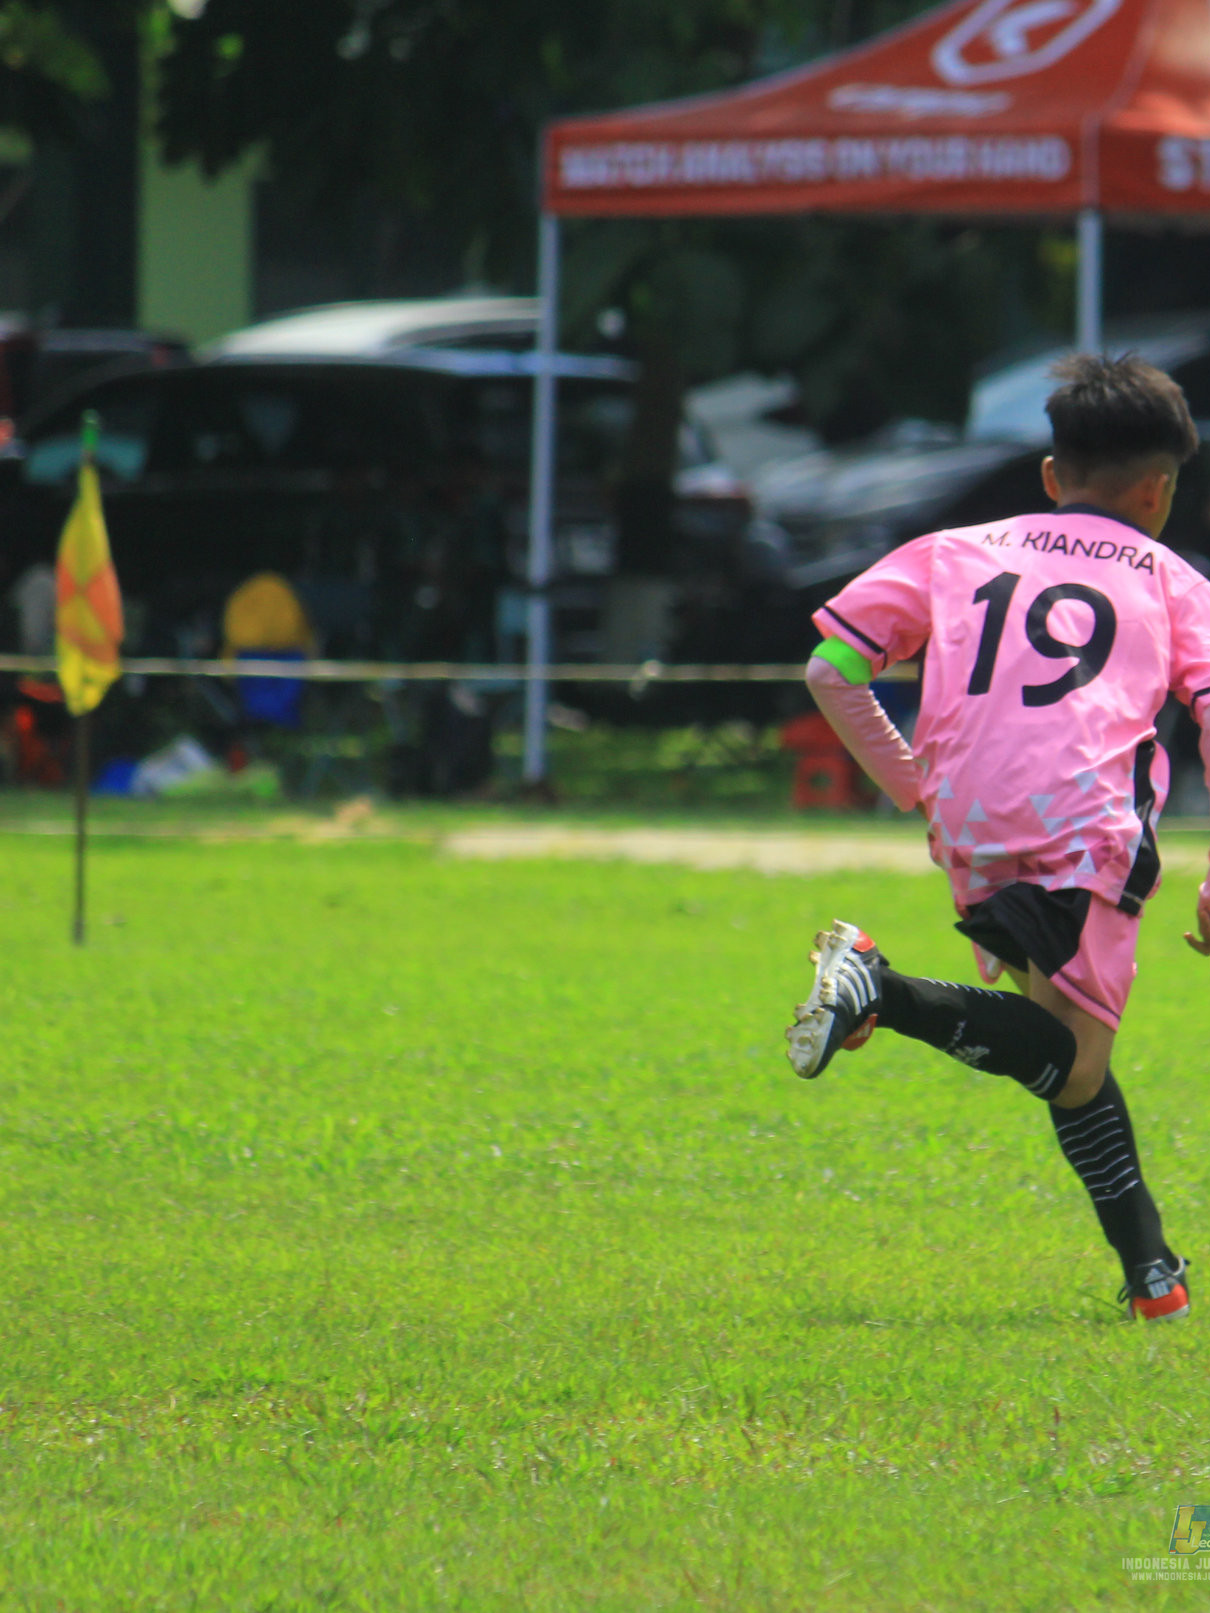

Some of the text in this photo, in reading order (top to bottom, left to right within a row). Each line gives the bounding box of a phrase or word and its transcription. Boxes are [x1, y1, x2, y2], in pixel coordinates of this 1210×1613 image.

[981, 531, 1155, 576] M. KIANDRA
[967, 571, 1117, 707] 19
